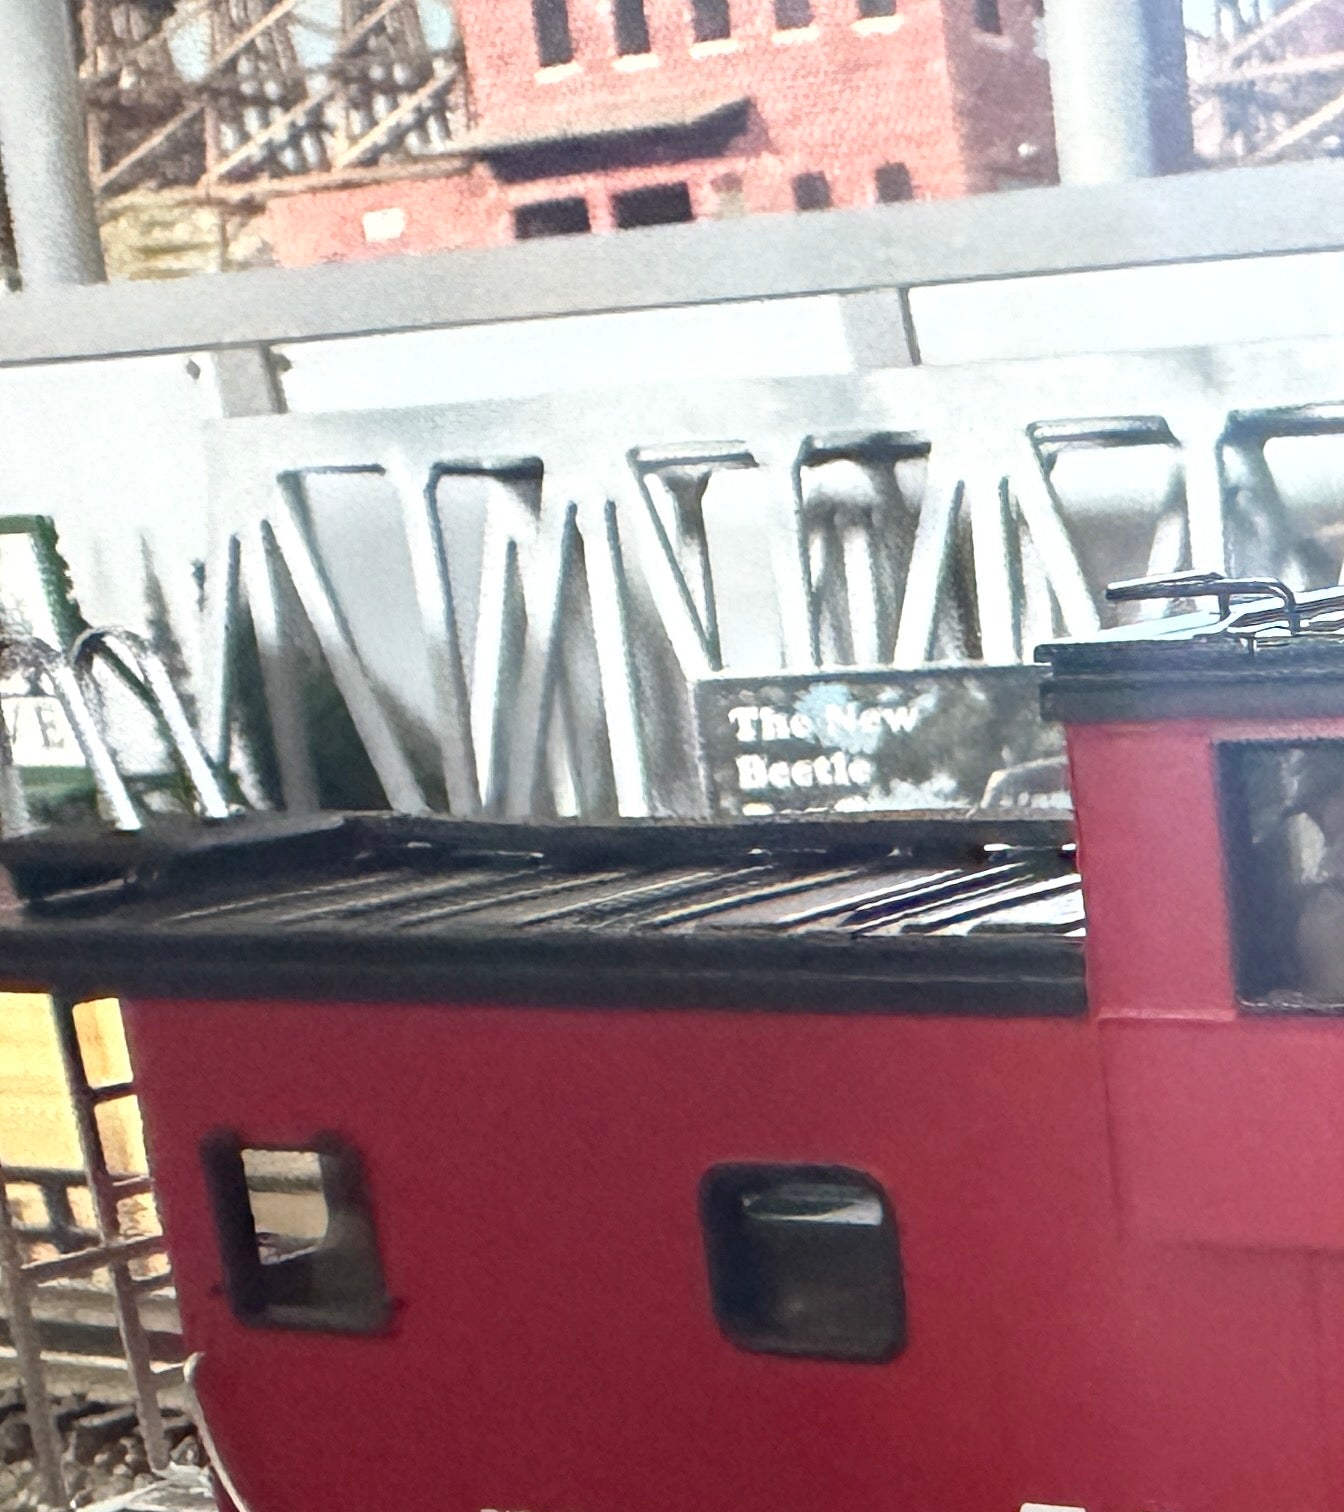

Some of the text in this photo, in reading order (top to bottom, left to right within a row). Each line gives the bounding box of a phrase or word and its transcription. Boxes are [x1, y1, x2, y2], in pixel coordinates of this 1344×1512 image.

[728, 704, 920, 742] The New
[735, 752, 873, 789] Beetle
